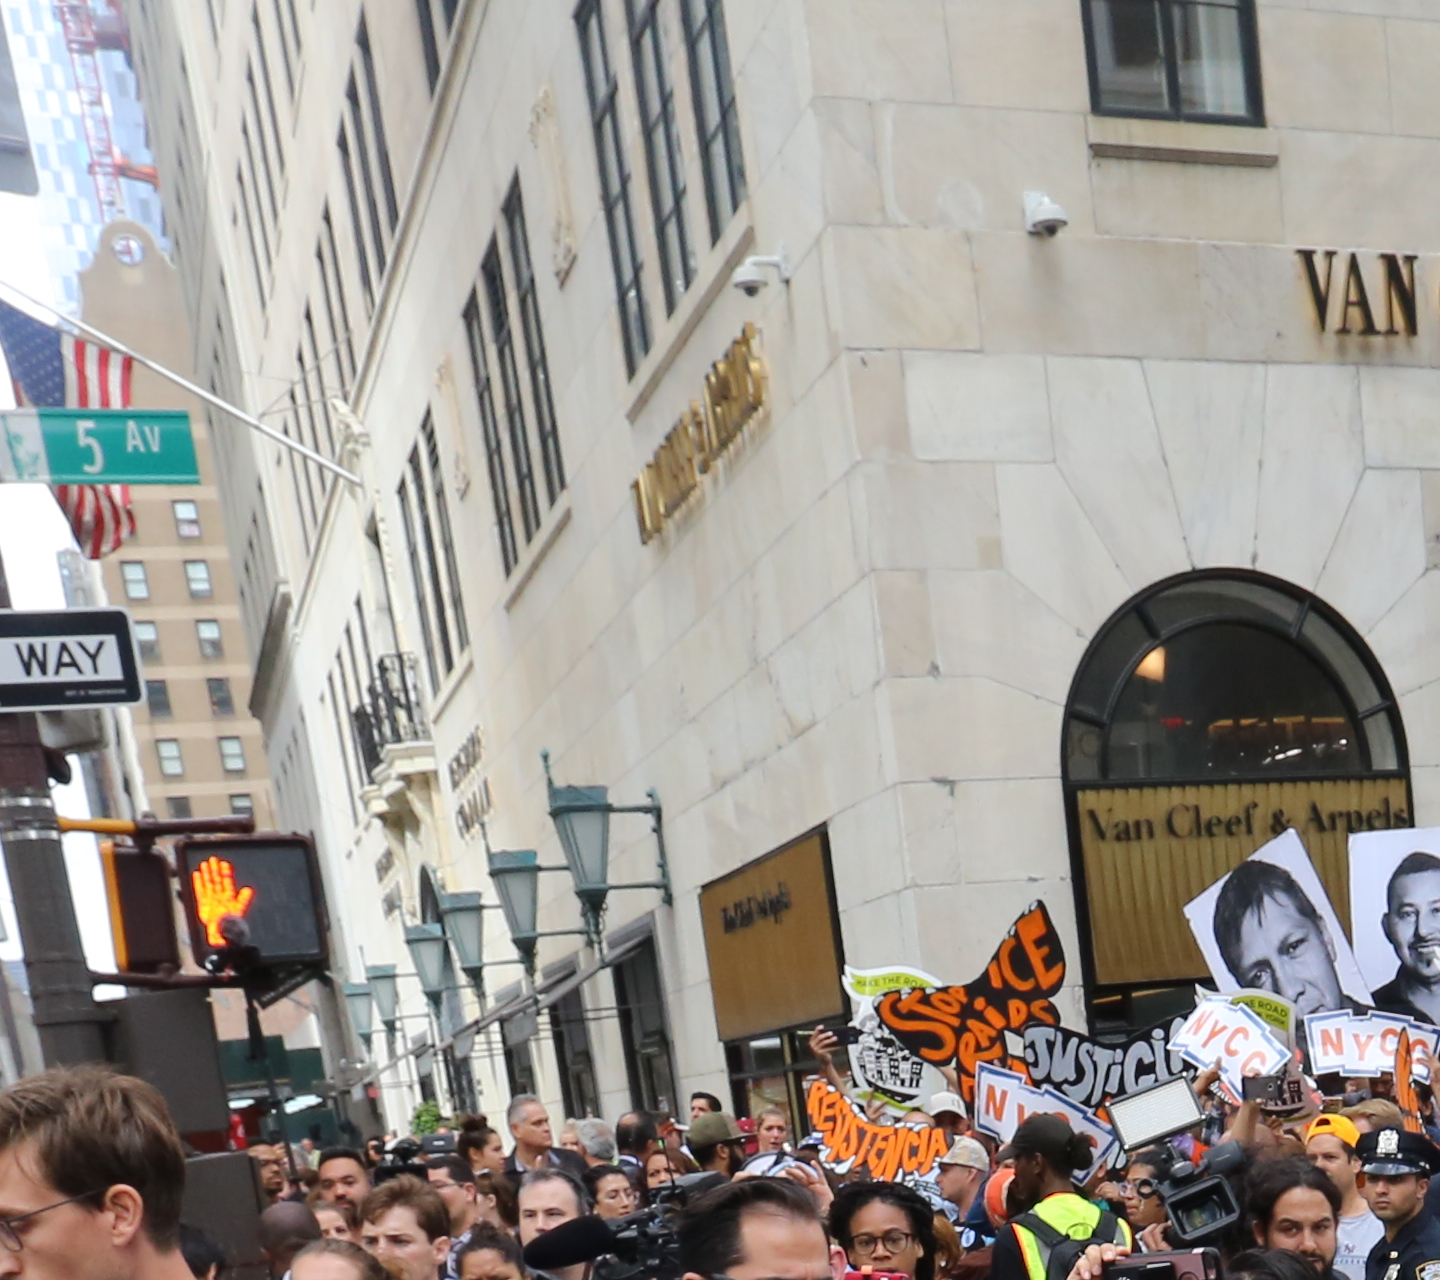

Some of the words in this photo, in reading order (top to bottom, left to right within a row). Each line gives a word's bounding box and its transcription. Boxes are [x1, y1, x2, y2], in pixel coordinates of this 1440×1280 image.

[1296, 248, 1419, 337] VAN
[76, 419, 105, 474] 5
[15, 640, 106, 677] WAY
[1086, 807, 1154, 842] Van
[1165, 799, 1259, 839] Cleef
[1269, 809, 1292, 834] &
[989, 909, 1064, 990] ICE
[807, 1080, 949, 1183] RESISTENCIA
